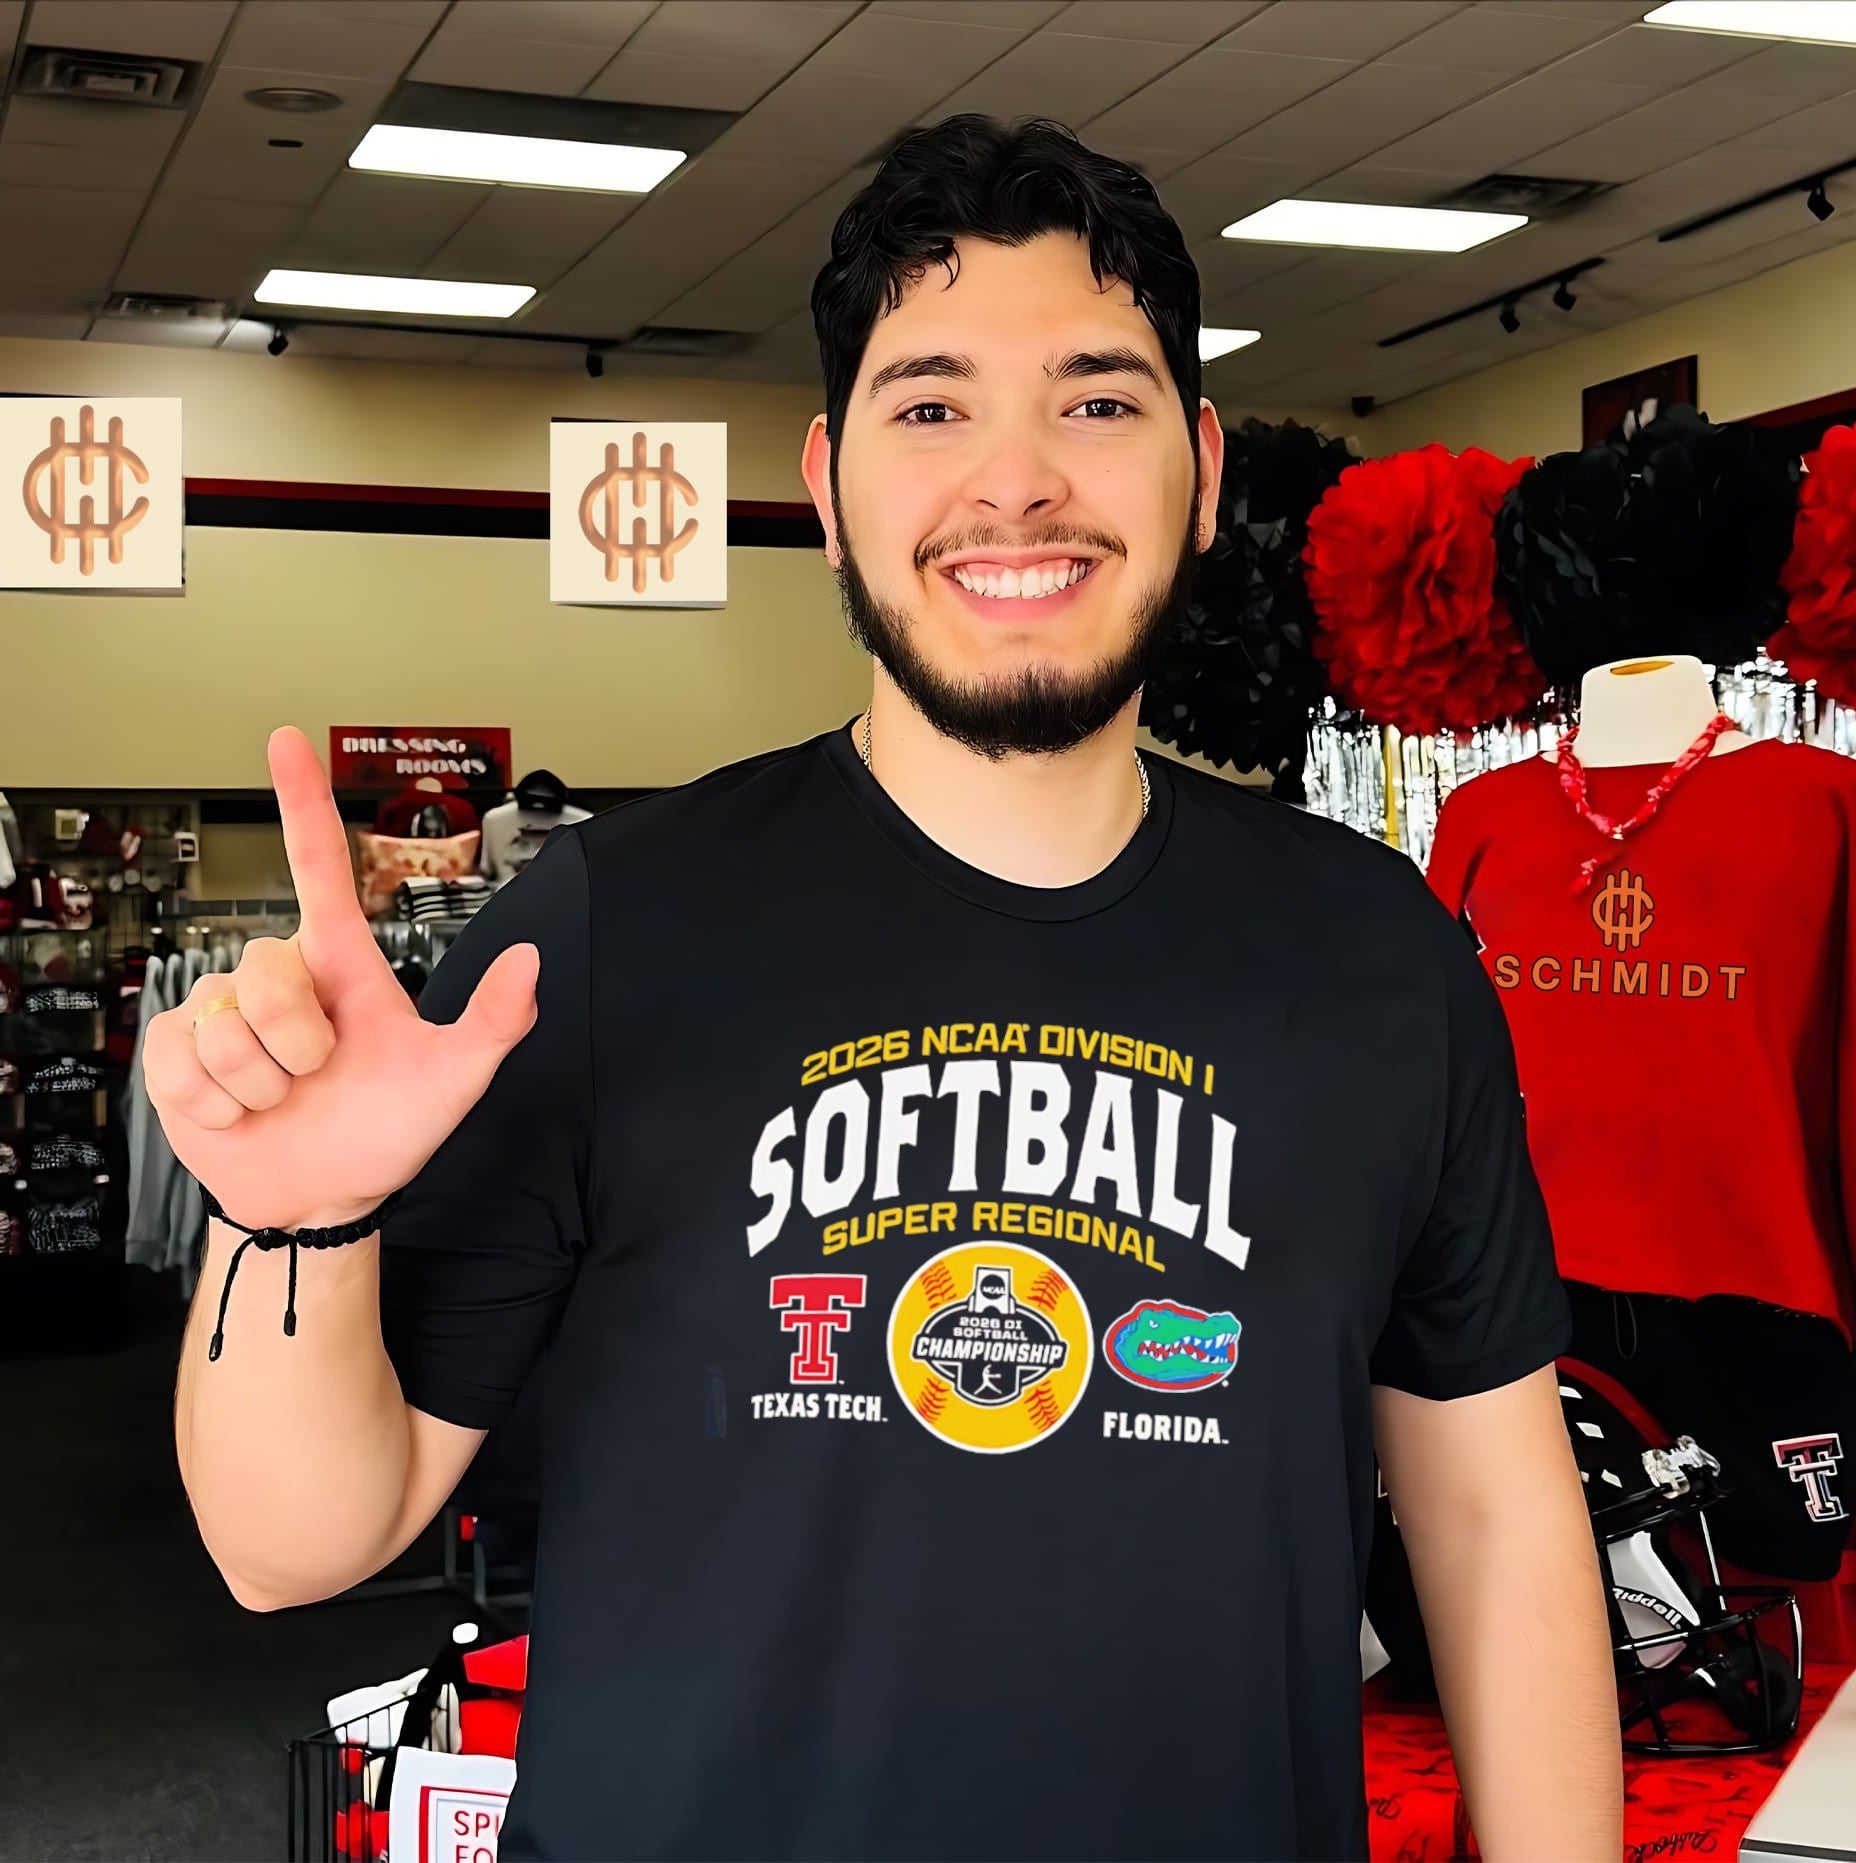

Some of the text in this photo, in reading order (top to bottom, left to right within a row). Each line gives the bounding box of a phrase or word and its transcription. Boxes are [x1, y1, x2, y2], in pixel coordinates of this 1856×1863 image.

[1493, 953, 1747, 1000] SCHMIDT
[801, 1029, 909, 1086] 2026
[1039, 1025, 1193, 1086] DIVISION
[1203, 1064, 1214, 1095] I
[746, 1059, 1251, 1271] SOFTBALL
[822, 1201, 1166, 1273] SUPER REGIONAL
[916, 1336, 1064, 1365] CHAMPIONSHIP
[953, 1327, 1028, 1341] SOFTBALL
[751, 1392, 820, 1419] TEXAS
